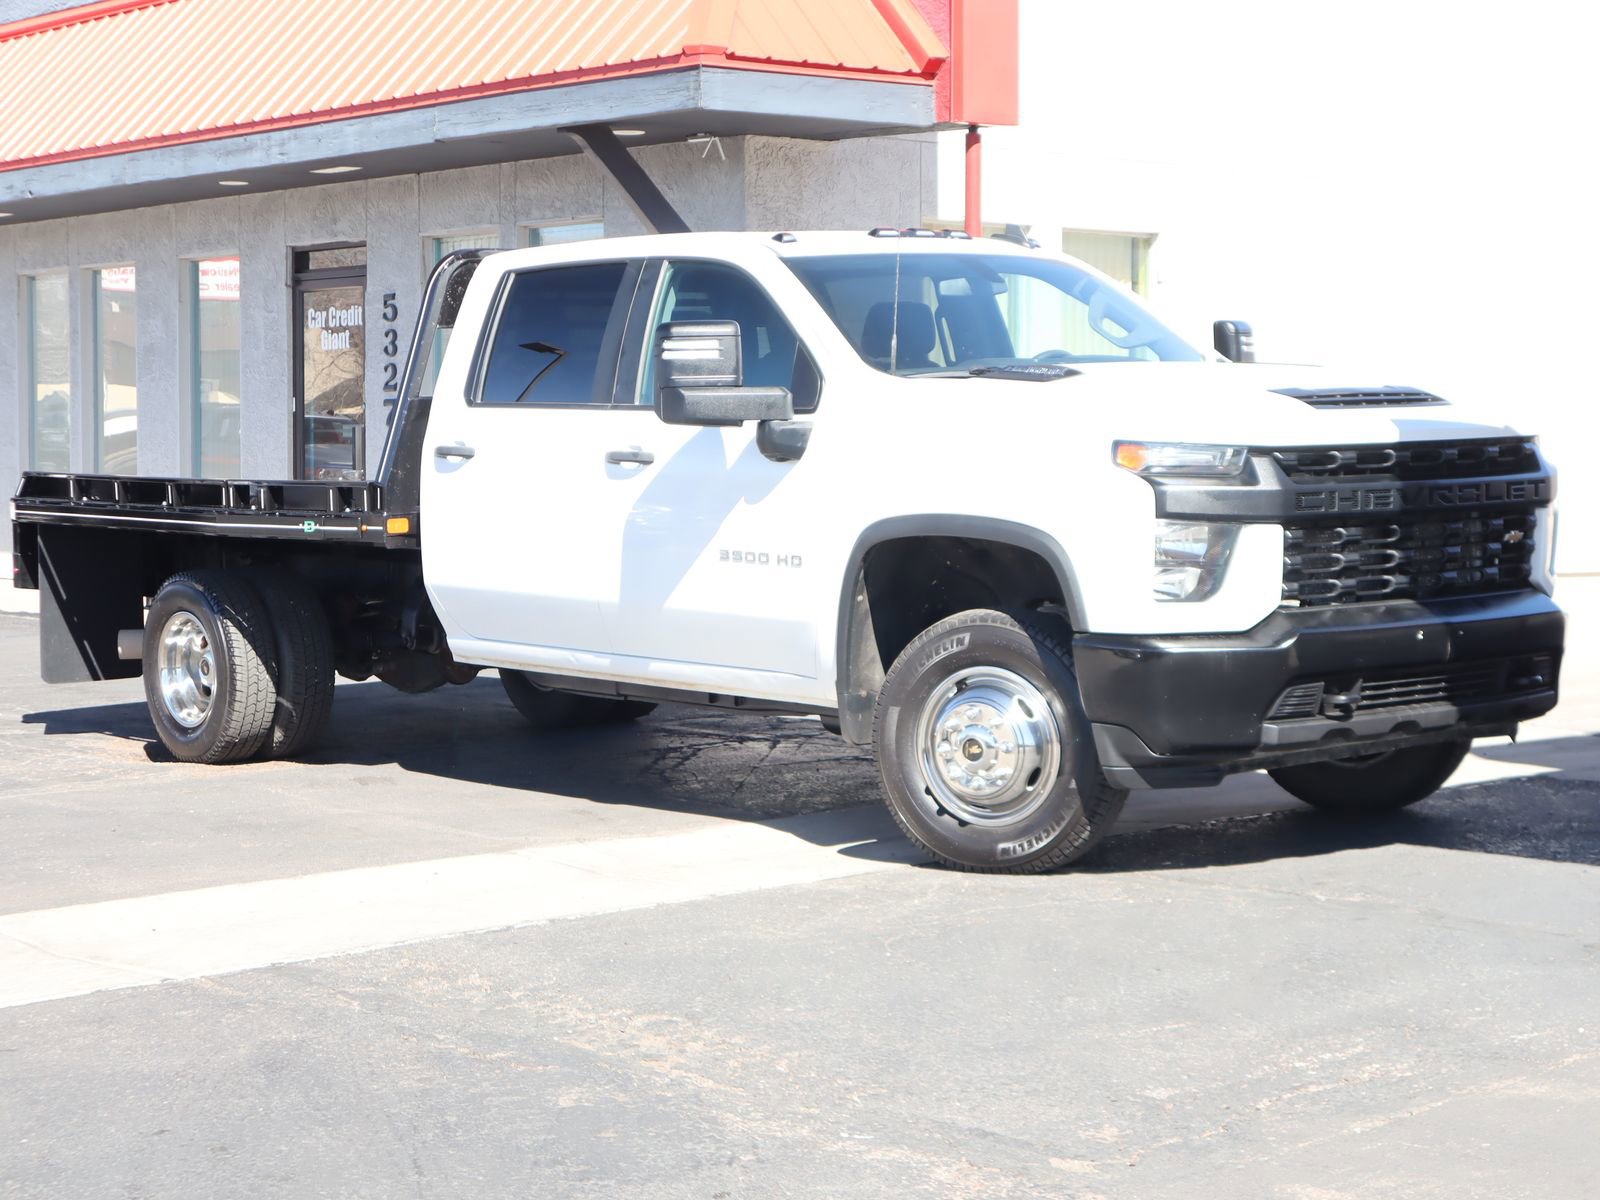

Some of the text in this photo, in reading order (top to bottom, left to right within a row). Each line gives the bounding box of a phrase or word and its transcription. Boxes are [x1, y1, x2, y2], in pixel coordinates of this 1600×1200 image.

[308, 304, 363, 329] Car Credit
[320, 329, 351, 351] Giant
[1294, 479, 1547, 512] CHEVROLET
[719, 549, 803, 568] 3500 HD
[908, 634, 969, 680] ICHELIN
